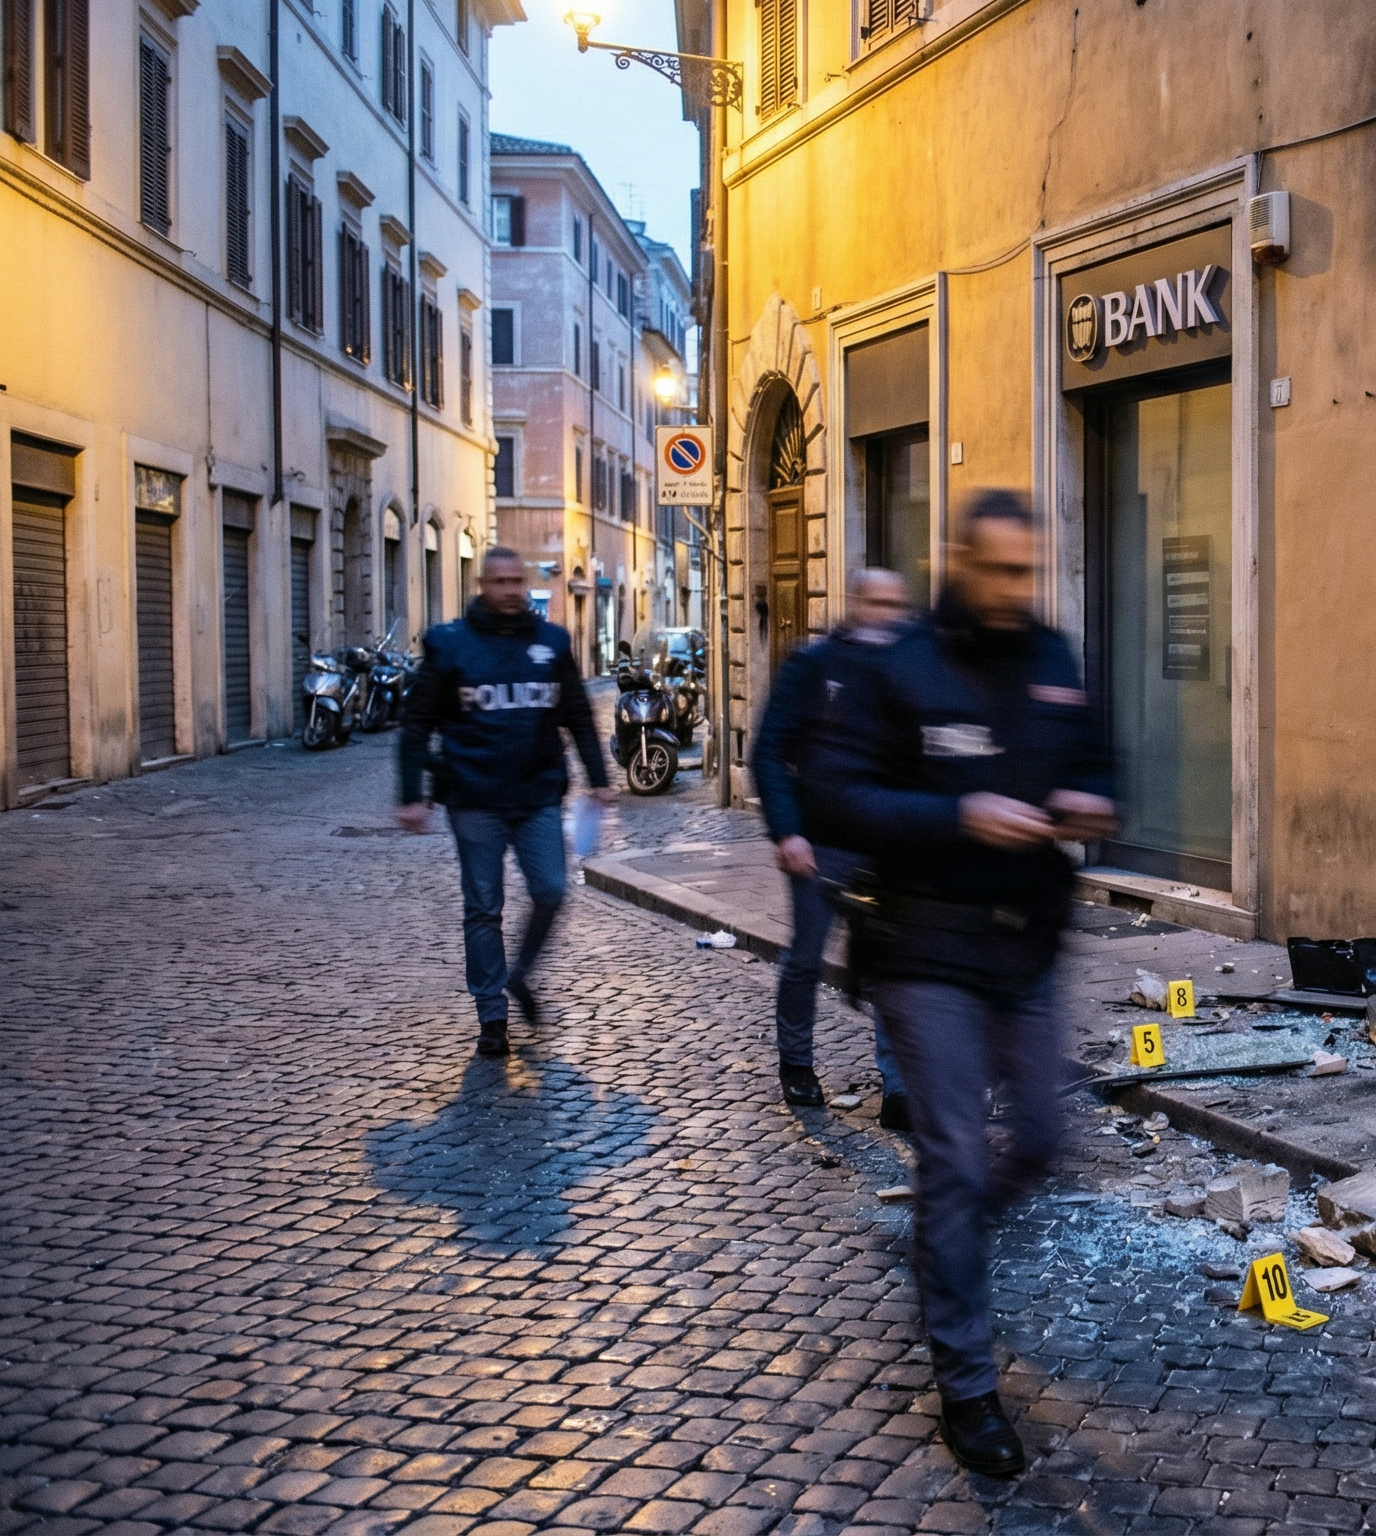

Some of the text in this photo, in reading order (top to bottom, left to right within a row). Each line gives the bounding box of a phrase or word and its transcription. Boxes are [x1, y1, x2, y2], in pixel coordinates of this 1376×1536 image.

[1101, 264, 1220, 347] BANK
[1177, 988, 1187, 1007] 8
[1143, 1031, 1155, 1053] 5
[1262, 1264, 1287, 1301] 10
